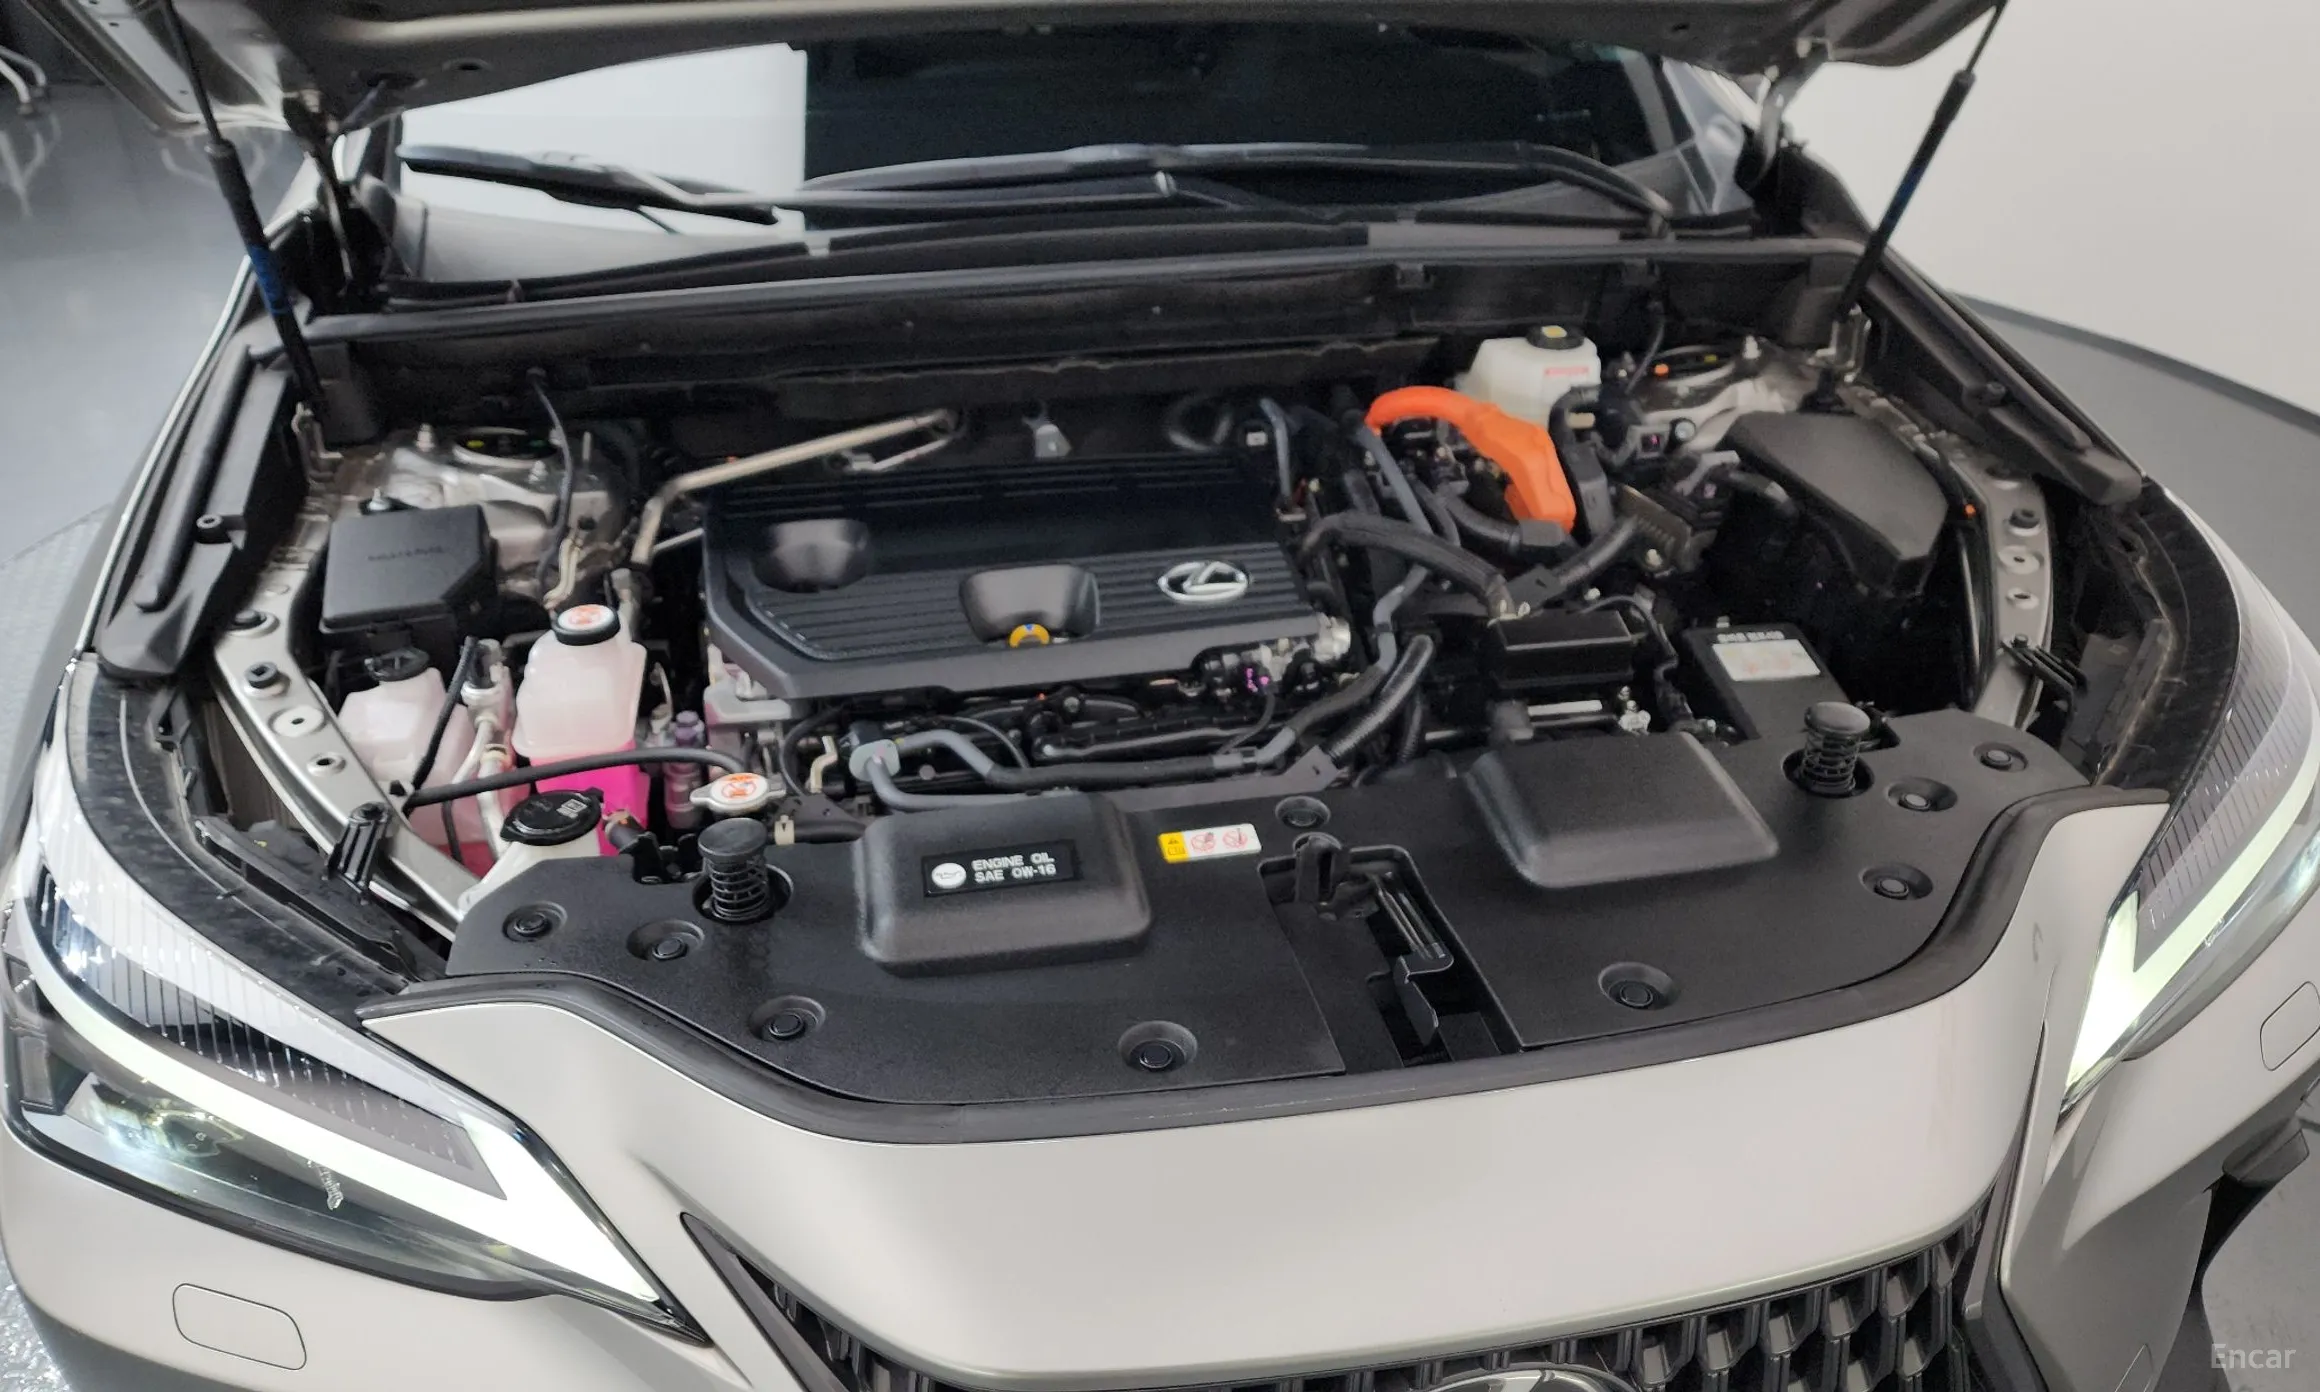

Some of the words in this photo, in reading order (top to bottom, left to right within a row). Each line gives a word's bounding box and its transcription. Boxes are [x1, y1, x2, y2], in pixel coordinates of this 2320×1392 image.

[971, 854, 1025, 872] ENGINE
[1030, 851, 1056, 865] OIL
[974, 868, 1005, 884] SAE
[1011, 863, 1057, 880] 0W-16
